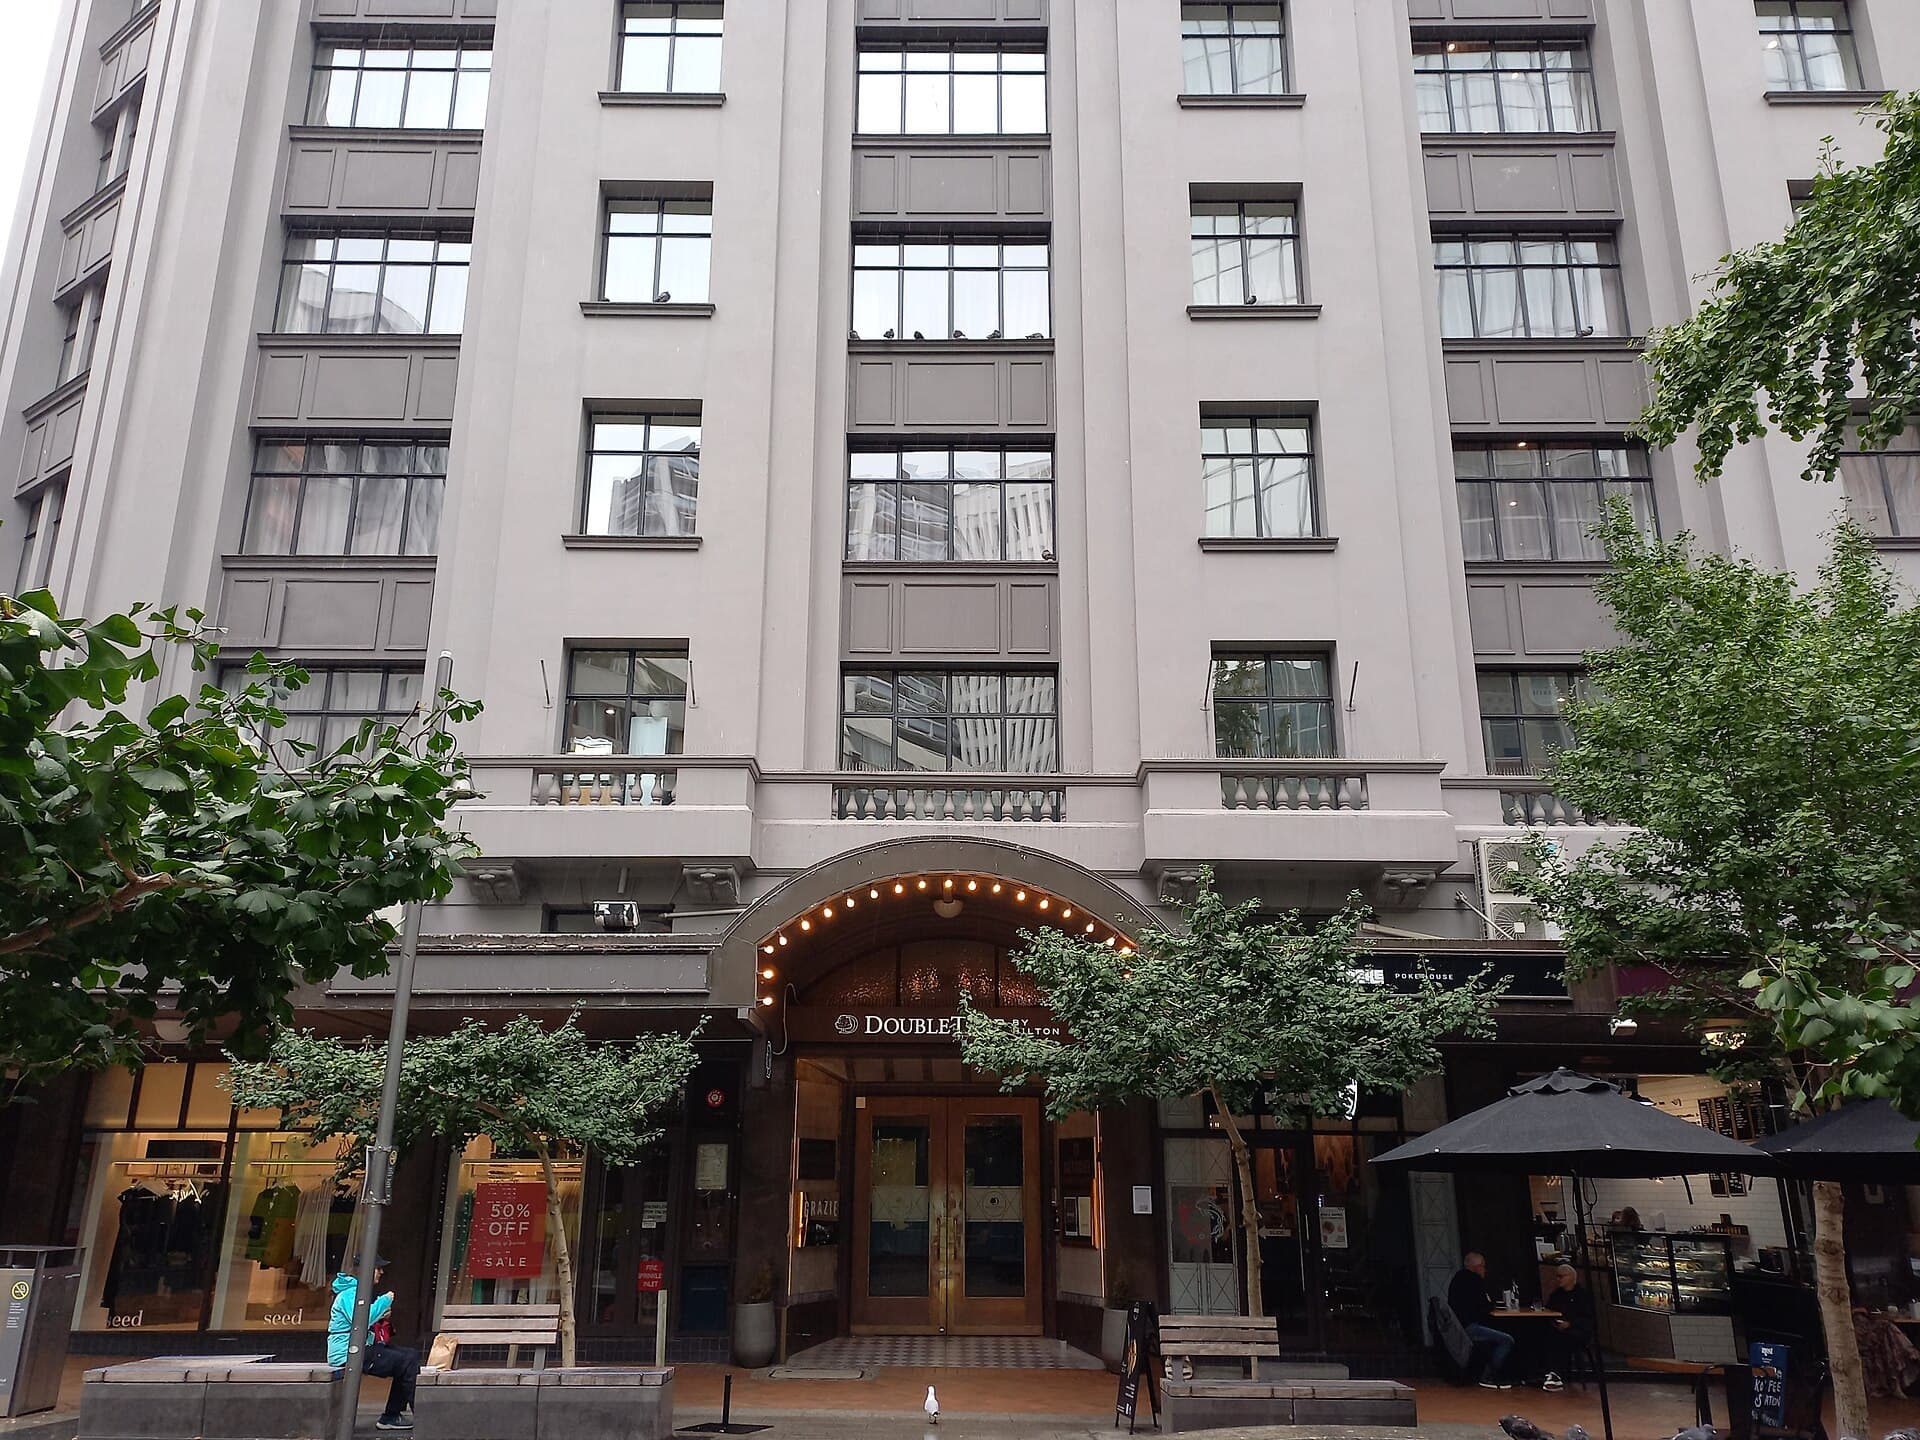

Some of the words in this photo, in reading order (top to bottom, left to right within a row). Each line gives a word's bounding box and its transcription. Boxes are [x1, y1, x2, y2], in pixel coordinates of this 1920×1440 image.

[864, 1015, 1005, 1034] DOUBLET
[490, 1204, 530, 1218] 50%
[804, 1200, 839, 1217] GRAZIE
[488, 1221, 530, 1236] OFF
[485, 1257, 527, 1267] SALE
[263, 1308, 304, 1326] seed
[1754, 1379, 1782, 1393] KOFEE
[1754, 1394, 1781, 1408] SATION
